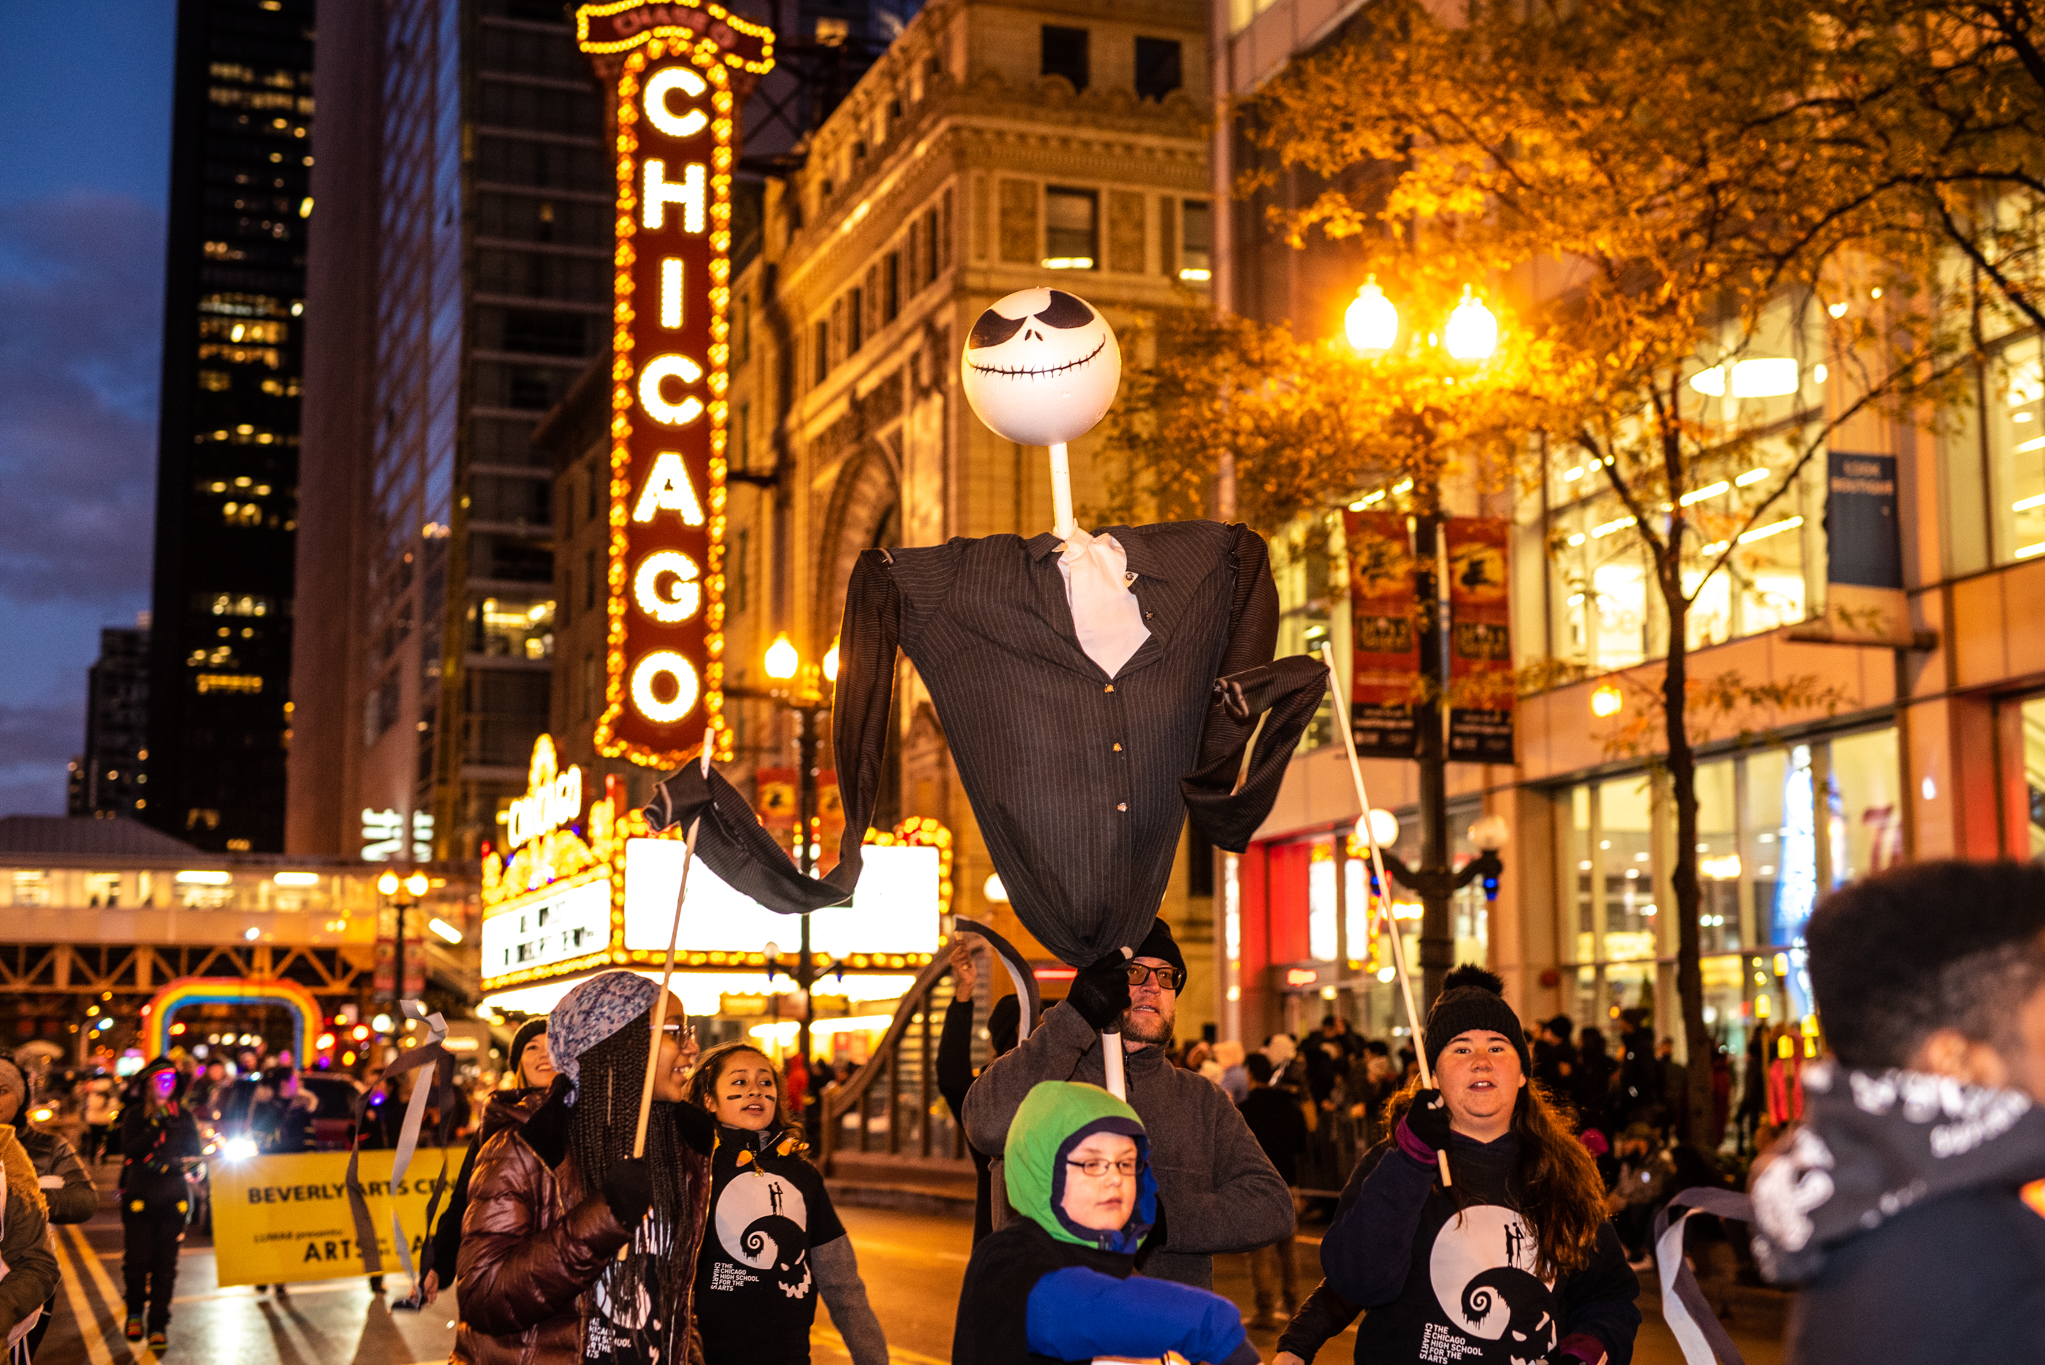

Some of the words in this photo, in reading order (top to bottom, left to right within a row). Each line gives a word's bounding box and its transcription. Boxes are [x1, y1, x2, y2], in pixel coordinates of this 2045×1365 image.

[630, 67, 709, 723] CHICAGO
[249, 1183, 345, 1204] BEVERLY
[719, 1273, 735, 1281] HIGH
[735, 1274, 760, 1283] SCHOOL
[720, 1268, 747, 1276] CHICAGO
[717, 1284, 734, 1292] ARTS
[1434, 1324, 1449, 1334] THE
[1419, 1323, 1433, 1359] CHIARTS
[1432, 1333, 1465, 1345] CHICAGO
[1430, 1347, 1445, 1356] FOR
[1446, 1351, 1462, 1360] THE
[1431, 1340, 1449, 1349] HIGH
[1451, 1344, 1483, 1356] SCHOOL
[1427, 1354, 1448, 1365] ARTS
